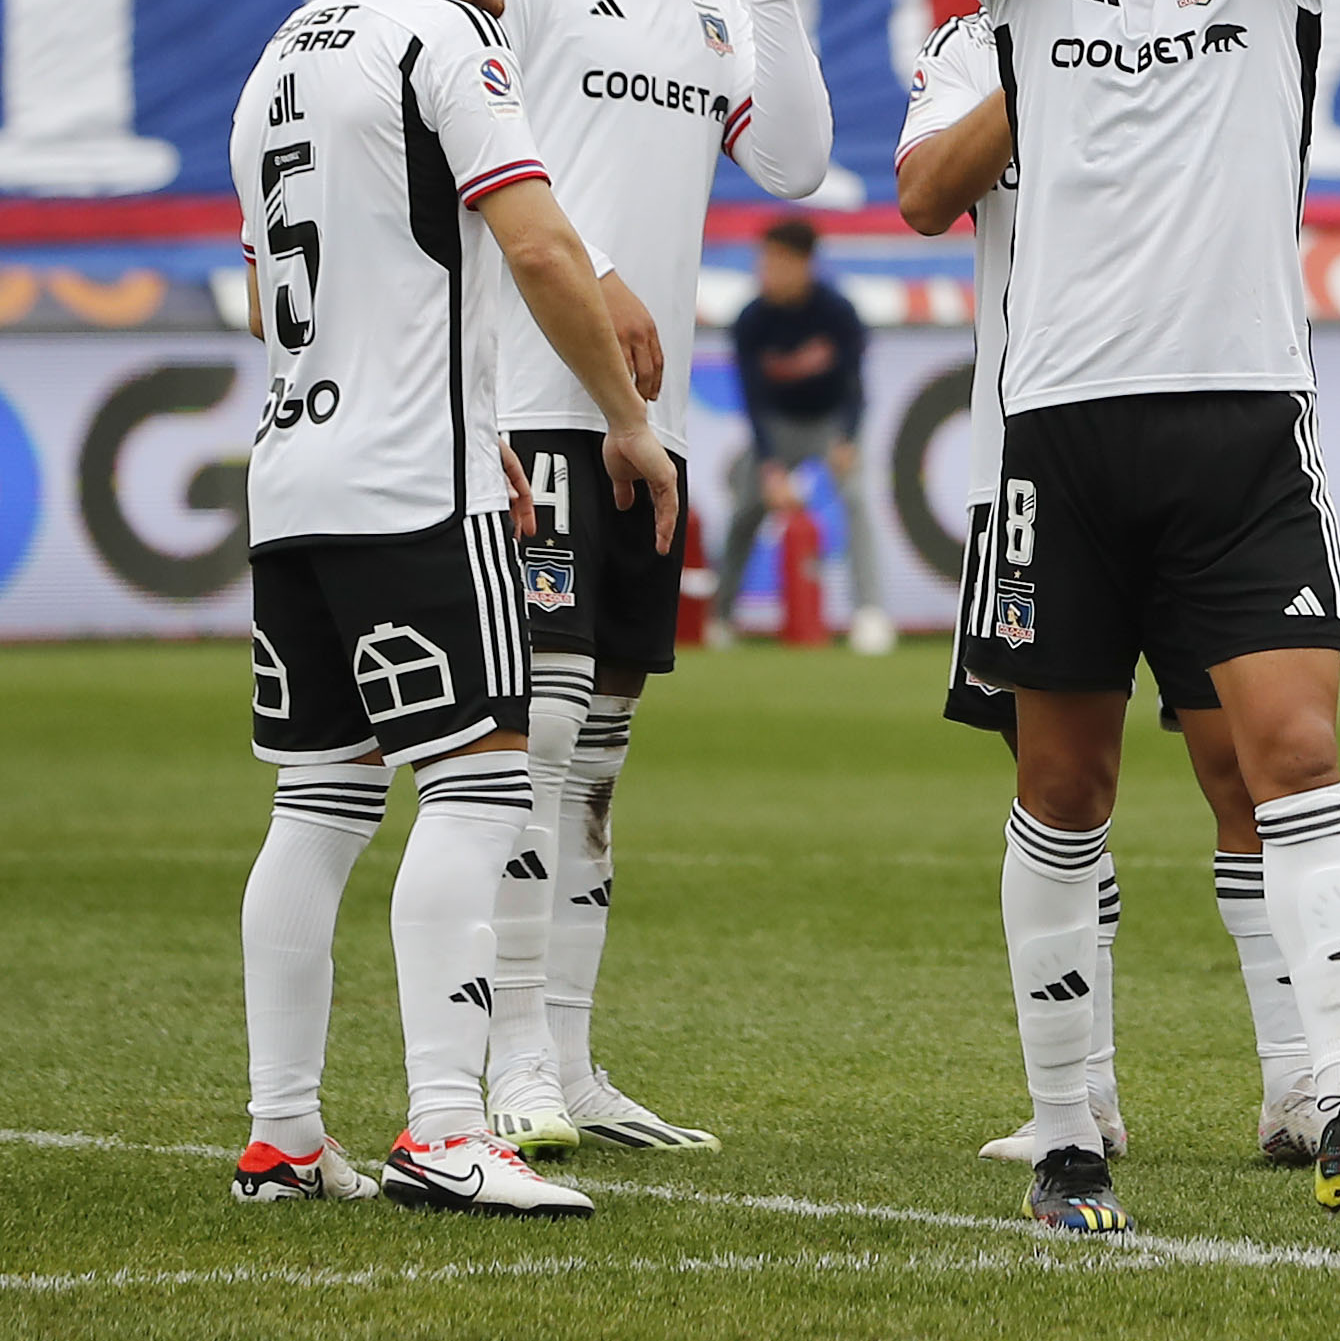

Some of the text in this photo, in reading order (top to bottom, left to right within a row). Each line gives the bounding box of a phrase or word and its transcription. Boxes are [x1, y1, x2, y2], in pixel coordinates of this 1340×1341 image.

[582, 70, 710, 116] COOLBET
[262, 141, 321, 355] 5
[1006, 478, 1037, 566] 8
